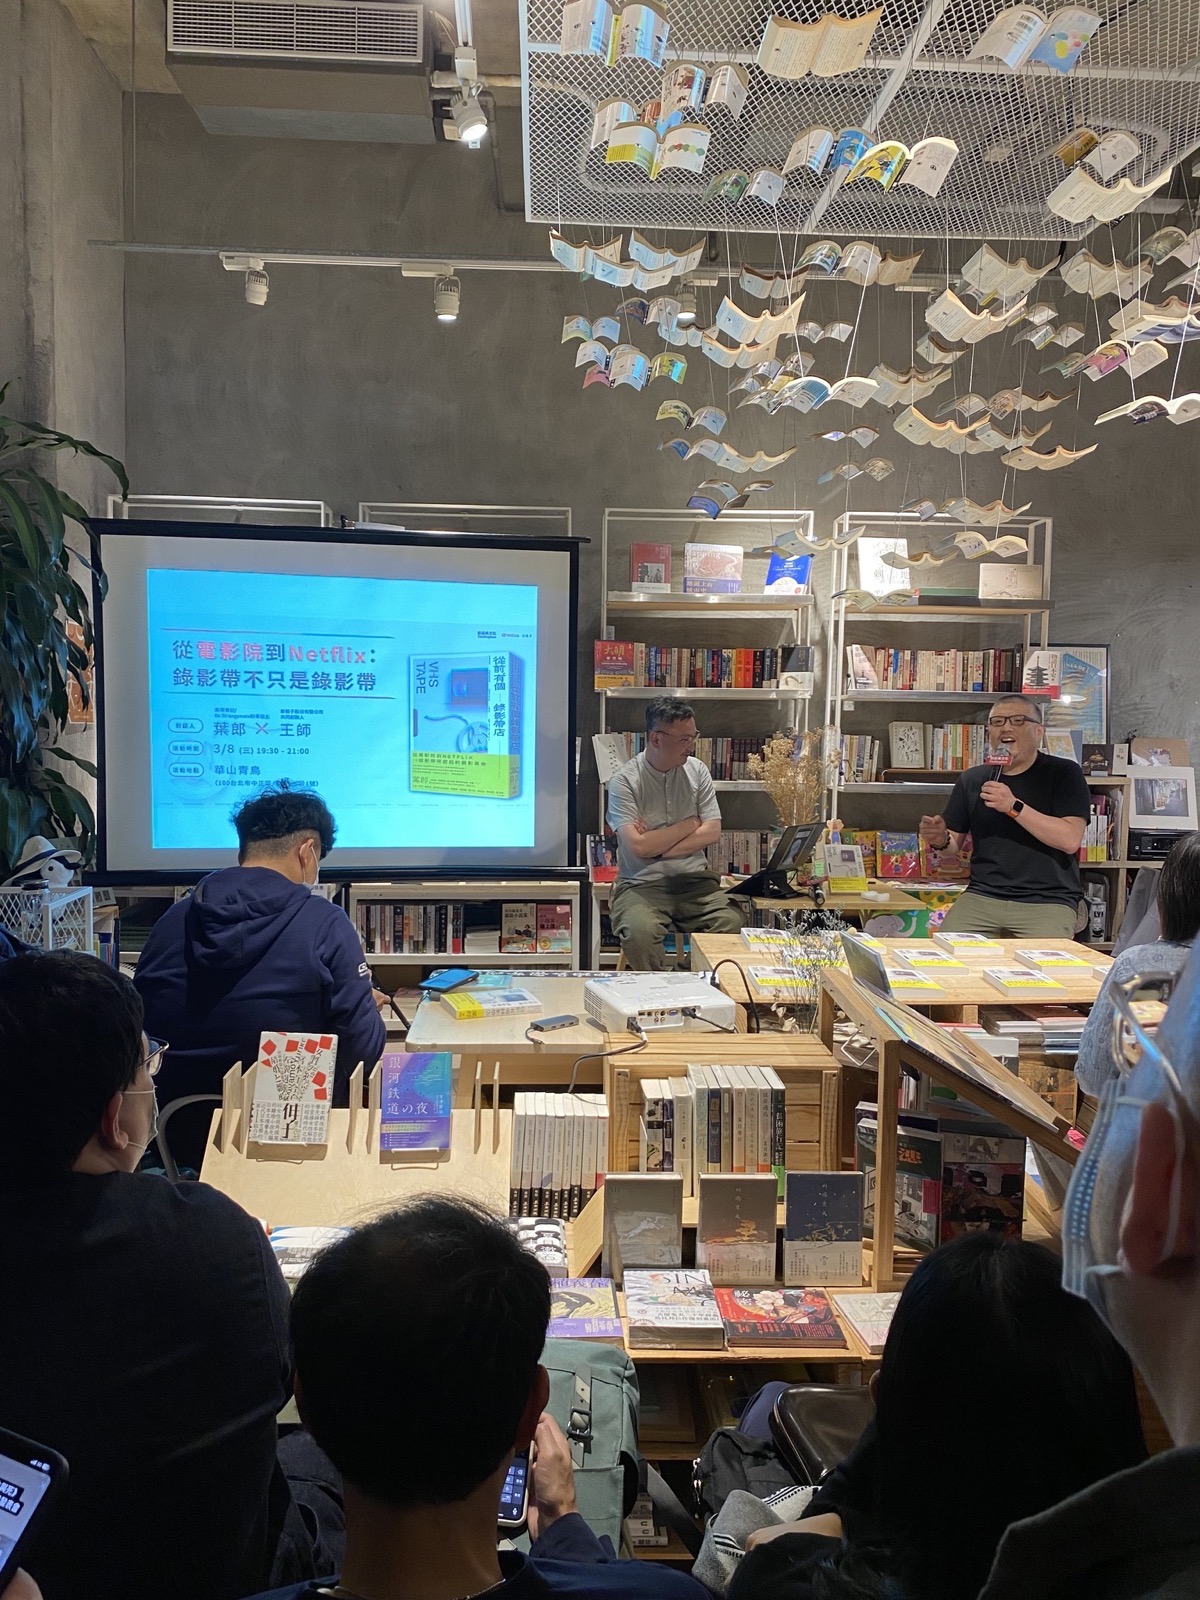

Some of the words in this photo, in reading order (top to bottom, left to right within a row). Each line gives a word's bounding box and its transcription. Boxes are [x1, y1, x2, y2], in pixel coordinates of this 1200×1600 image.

[173, 667, 376, 692] 錄影帶不只是錄影帶
[416, 661, 426, 694] TAPE
[428, 661, 439, 688] VHS
[213, 722, 246, 737] 葉郎
[280, 722, 312, 738] 王師
[213, 743, 235, 755] 3/8
[256, 747, 279, 755] 19:30
[287, 747, 309, 755] 21:00
[402, 1101, 428, 1115] の夜
